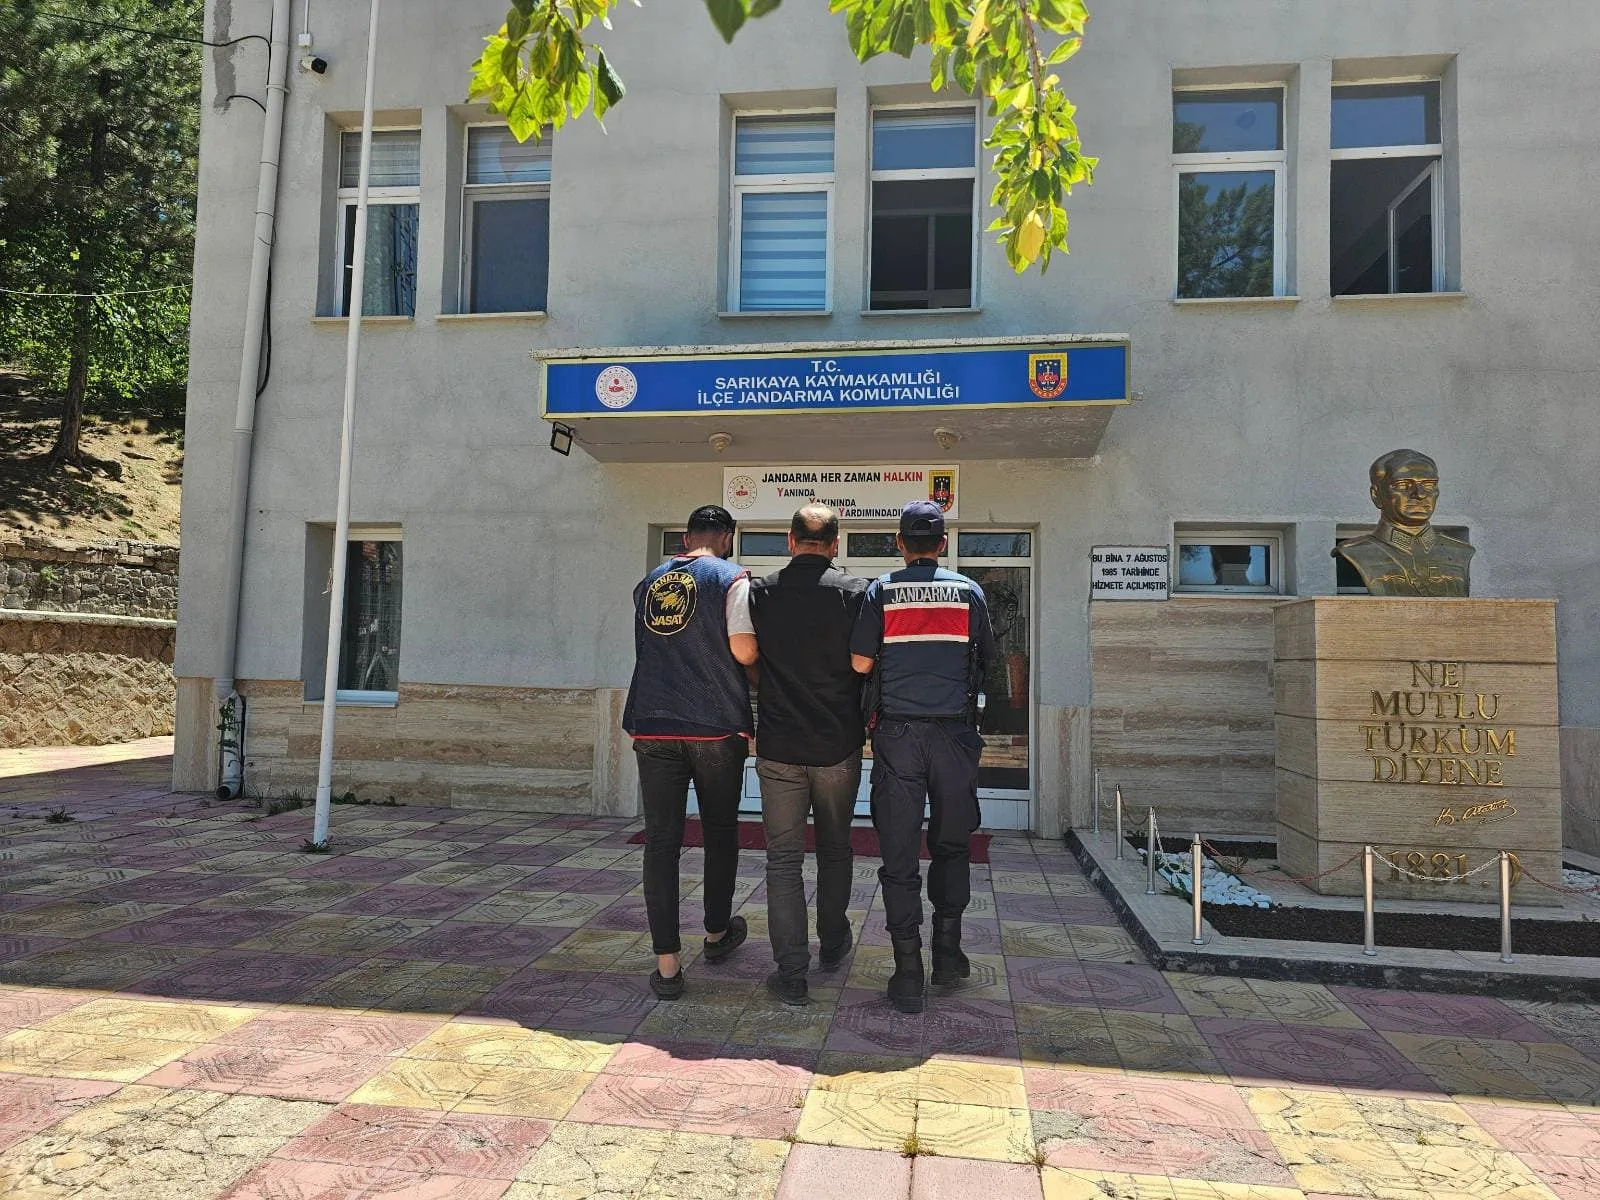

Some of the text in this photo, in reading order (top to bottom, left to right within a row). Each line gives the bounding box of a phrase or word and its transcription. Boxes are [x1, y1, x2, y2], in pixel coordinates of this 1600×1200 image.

[811, 360, 841, 373] T.C.
[715, 369, 940, 390] SARIKAYA KAYMAKAMLIĞI
[697, 384, 960, 407] İLÇE JANDARMA KOMUTANLIĞI
[761, 471, 923, 484] JANDARMA HER ZAMAN HALKIN
[776, 487, 815, 497] YANINDA
[1092, 554, 1103, 563] BU
[1105, 553, 1123, 563] BİNA
[1126, 554, 1132, 563] 7
[1121, 566, 1160, 577] TARİHİNDE
[650, 573, 694, 592] JANDARMA
[1092, 580, 1167, 592] HİZMETE AÇILMIŞTIR
[891, 587, 961, 603] JANDARMA
[651, 614, 683, 626] JASAT
[1411, 661, 1460, 688] NE
[1371, 690, 1501, 720] MUTLU
[1372, 752, 1504, 787] DİYENE
